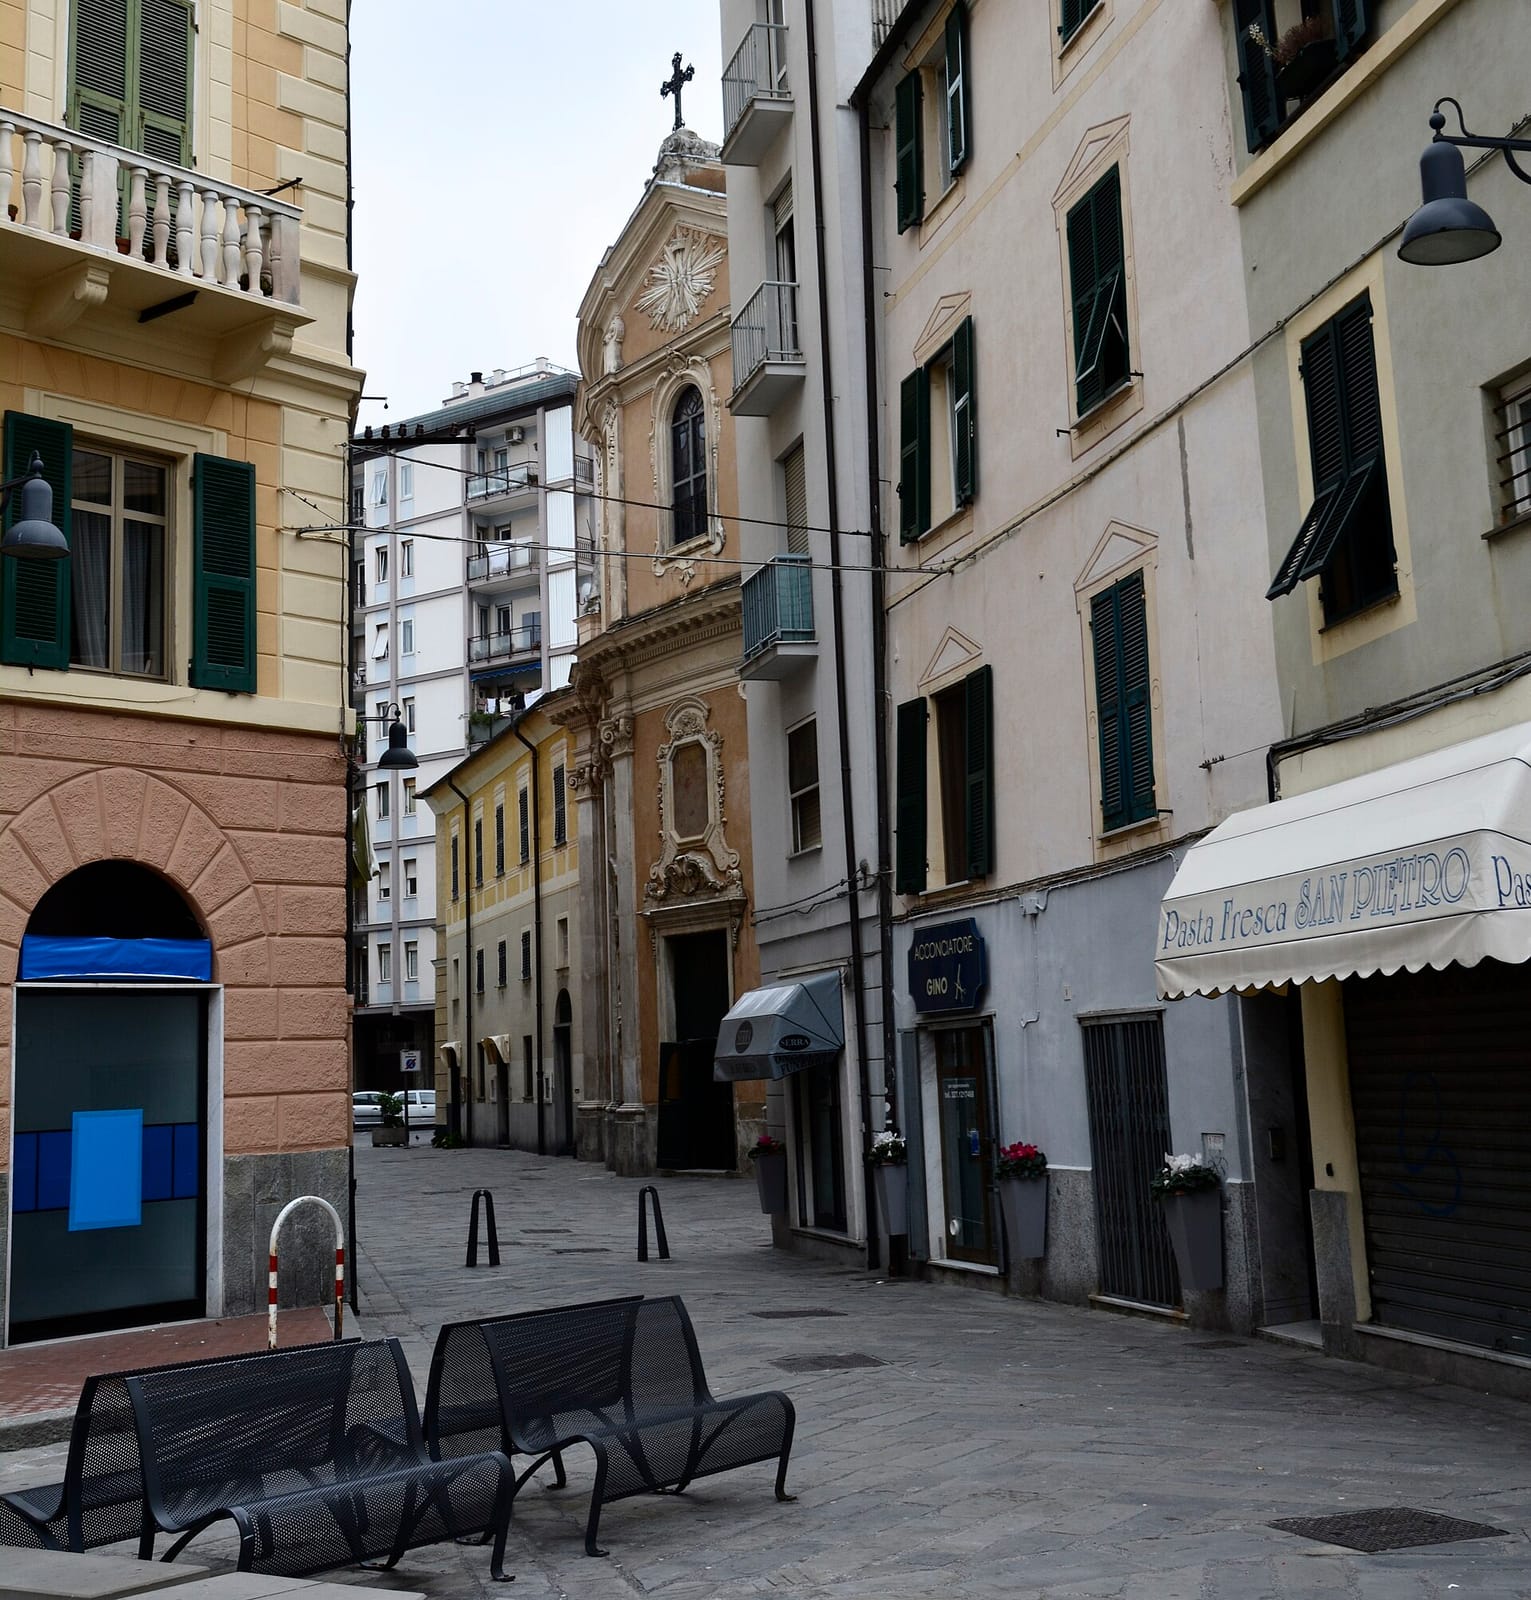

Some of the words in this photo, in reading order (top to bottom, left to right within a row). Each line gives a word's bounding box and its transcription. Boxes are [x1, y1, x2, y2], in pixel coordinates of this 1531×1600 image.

[1162, 907, 1214, 949] Pasta
[1220, 898, 1287, 941] Fresca
[1294, 873, 1348, 929] SAN
[1350, 847, 1471, 920] PIETRO
[914, 935, 973, 960] ACCONCIATORE
[926, 976, 948, 996] GINO
[780, 1037, 809, 1046] SERRA
